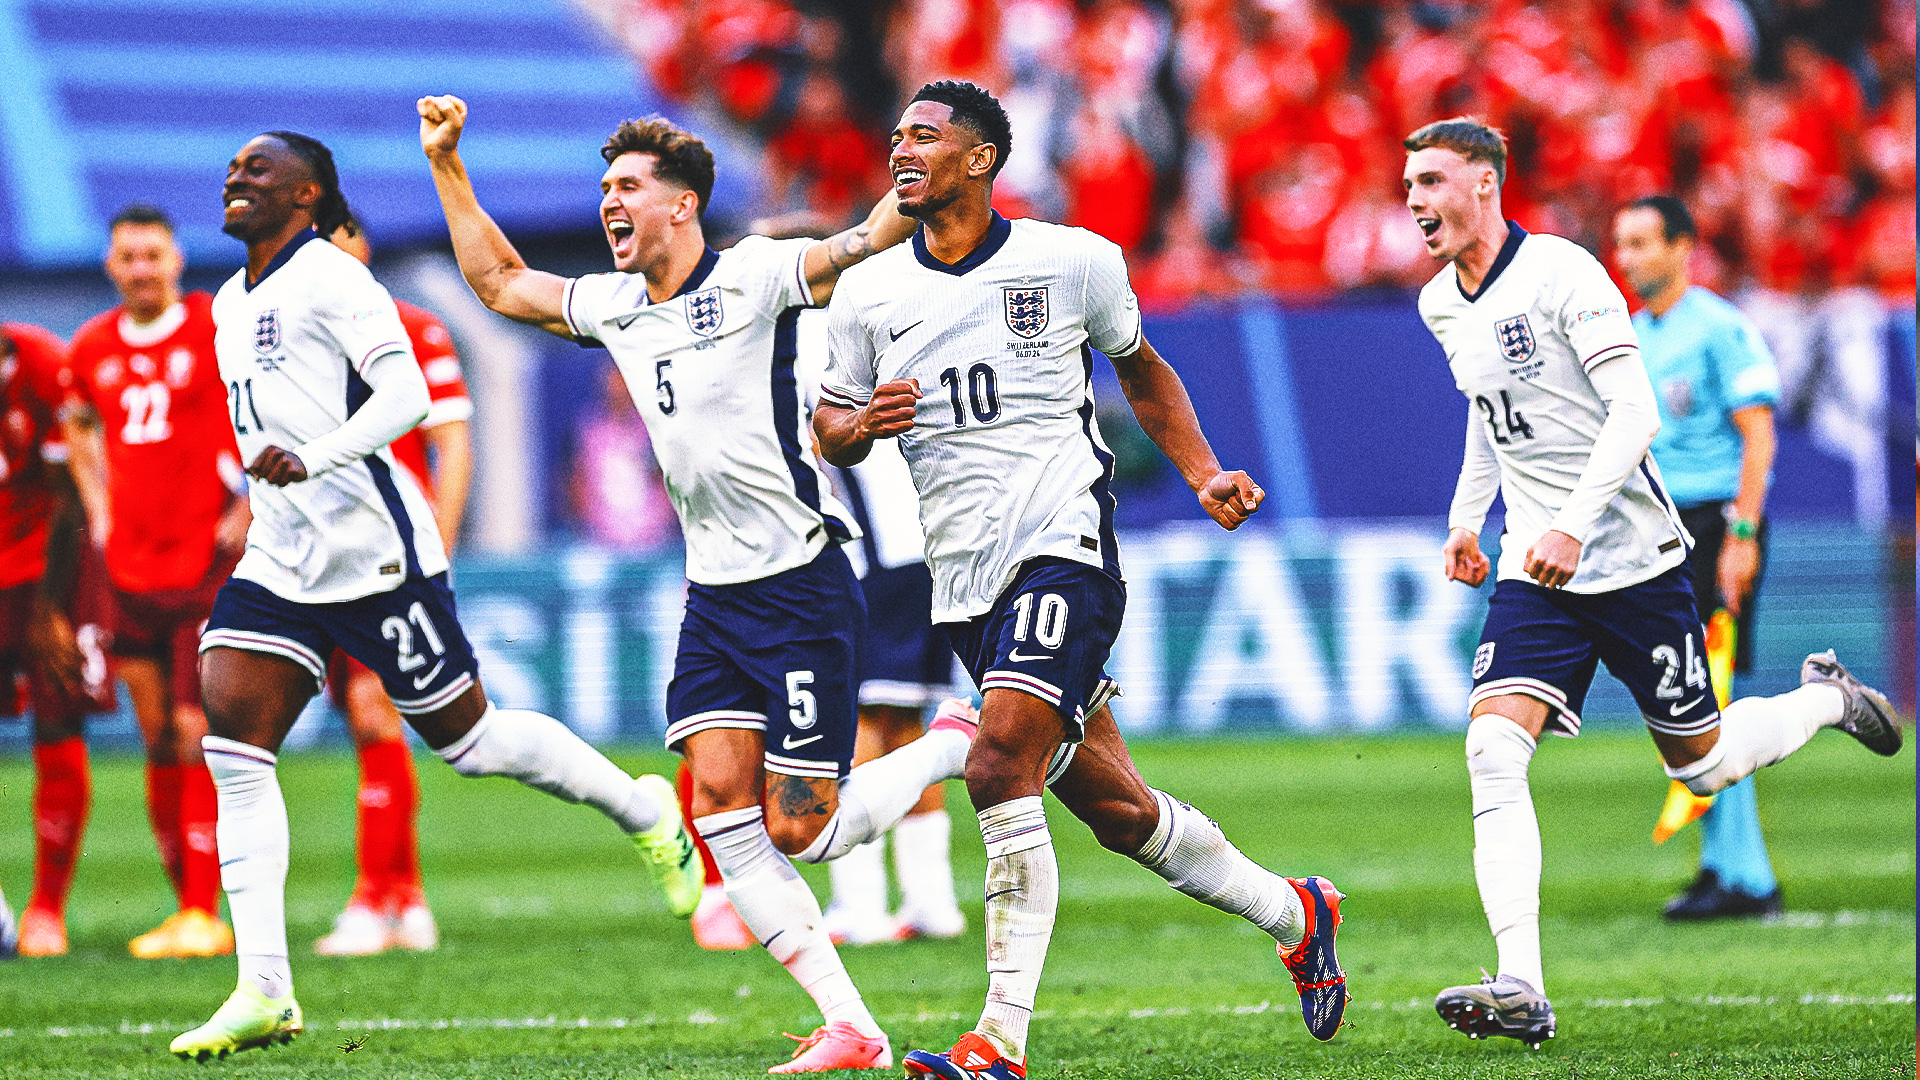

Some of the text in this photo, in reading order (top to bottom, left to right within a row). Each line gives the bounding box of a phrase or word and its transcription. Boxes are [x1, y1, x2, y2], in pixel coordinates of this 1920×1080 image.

[1006, 341, 1049, 349] SWITZERLAND
[230, 378, 264, 434] 21
[656, 359, 677, 416] 5
[939, 362, 1001, 428] 10
[1475, 390, 1534, 445] 24
[380, 600, 446, 672] 21
[1012, 592, 1069, 650] 10
[1112, 525, 1476, 733] TAR
[1651, 632, 1707, 700] 24
[785, 670, 818, 729] 5
